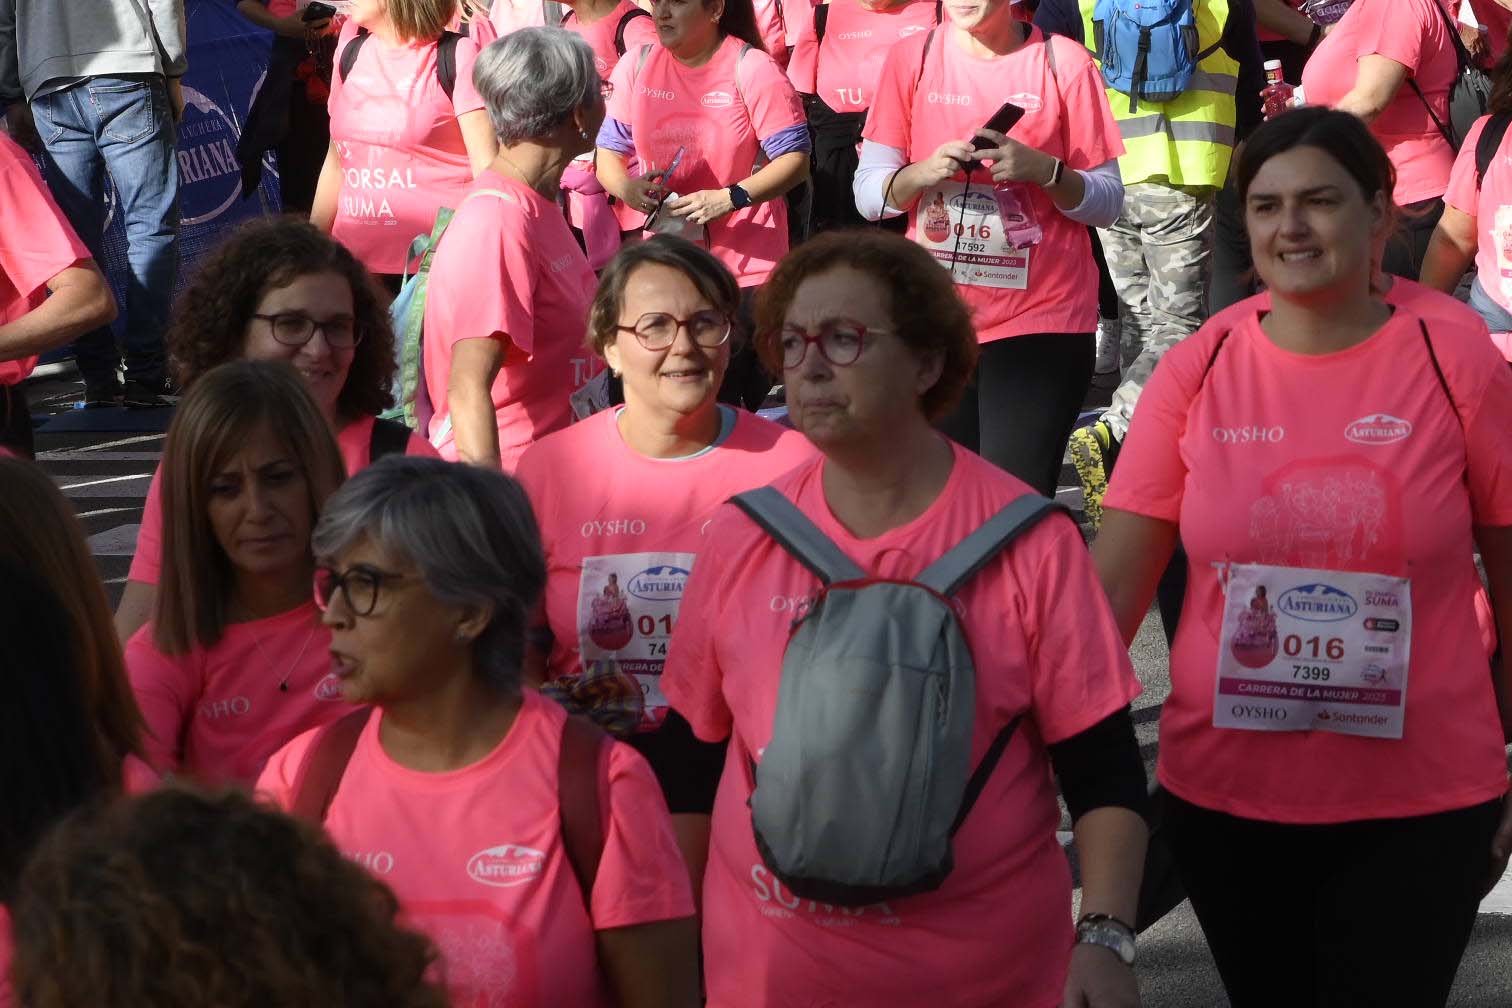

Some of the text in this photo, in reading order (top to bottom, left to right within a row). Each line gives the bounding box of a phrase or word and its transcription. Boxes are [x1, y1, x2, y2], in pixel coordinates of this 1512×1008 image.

[836, 88, 863, 105] TU
[953, 222, 991, 241] 016
[977, 256, 1000, 265] MUJER
[983, 271, 1019, 281] Santander
[1212, 425, 1286, 443] OYSHO
[1351, 426, 1407, 438] ASTURIANA
[581, 519, 647, 538] OYSHO
[1283, 595, 1352, 614] ASTURIANA
[1364, 596, 1400, 608] SUMA
[637, 614, 672, 636] 01
[1283, 633, 1345, 660] 016
[1291, 664, 1331, 681] 7399
[1237, 682, 1289, 696] CARRERA
[1290, 686, 1305, 698] DE
[1306, 687, 1321, 699] LA
[1323, 688, 1360, 701] MUJER
[1231, 704, 1288, 722] OYSHO
[1331, 709, 1389, 726] Santander
